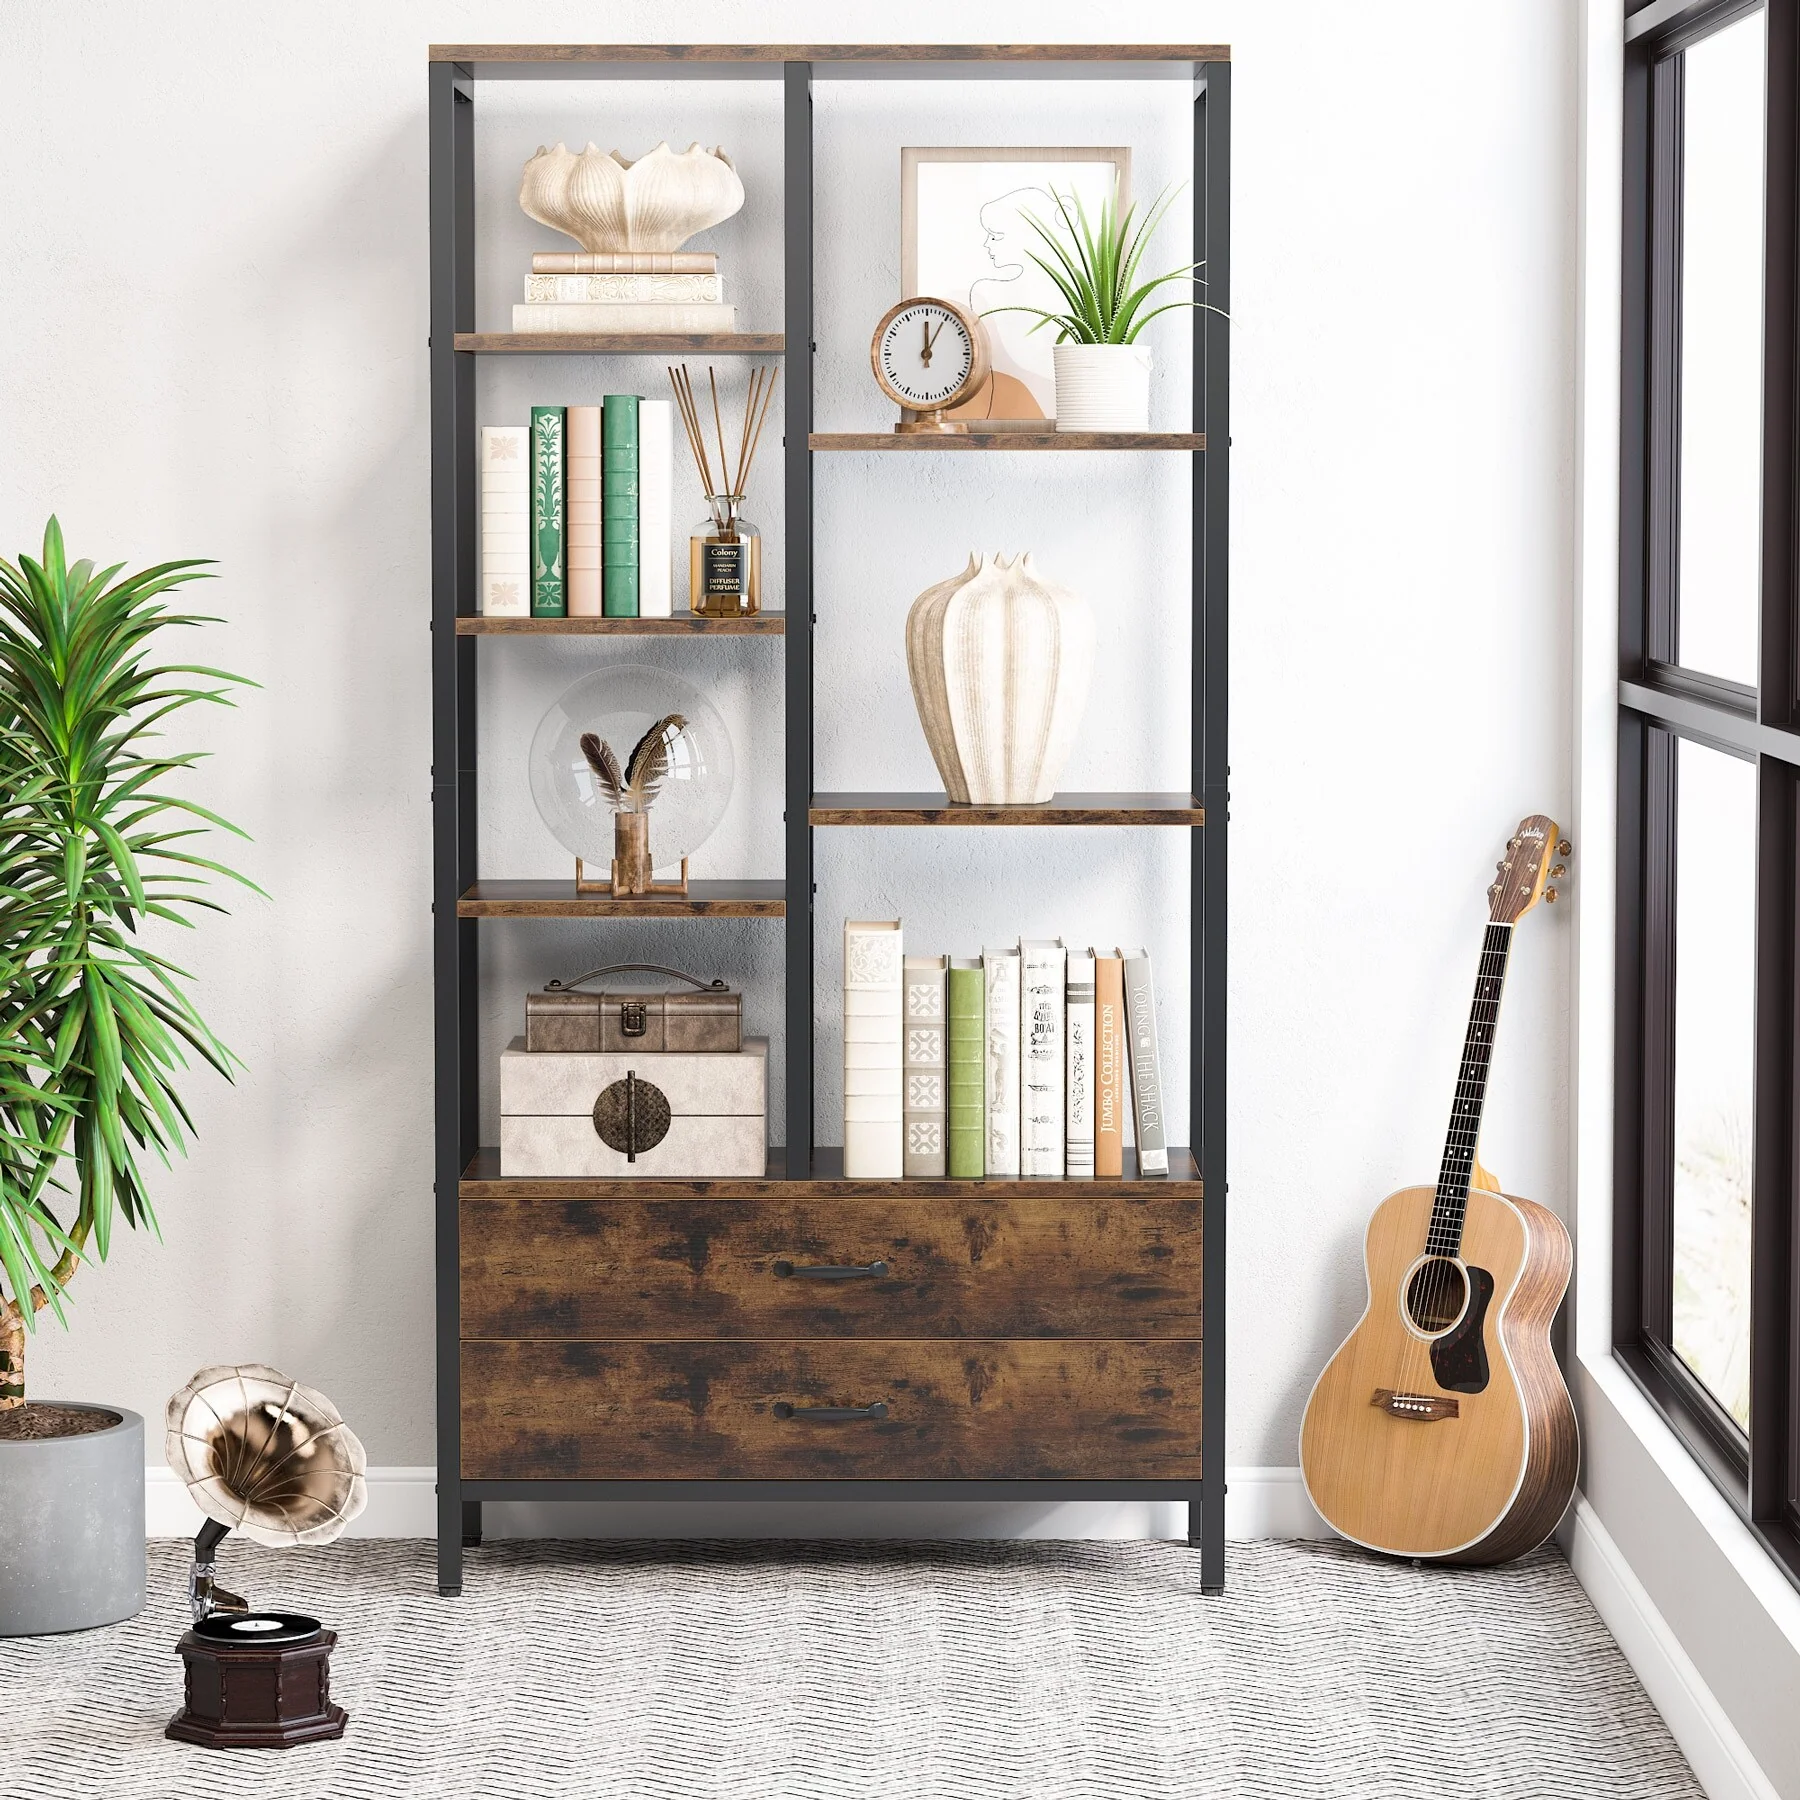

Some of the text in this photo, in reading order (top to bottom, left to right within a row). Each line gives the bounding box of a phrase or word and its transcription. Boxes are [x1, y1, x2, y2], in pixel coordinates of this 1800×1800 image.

[711, 548, 738, 557] Colony
[1100, 1003, 1117, 1133] JUMBO COLLECTION
[1133, 983, 1160, 1133] YOUNG THE SHACK
